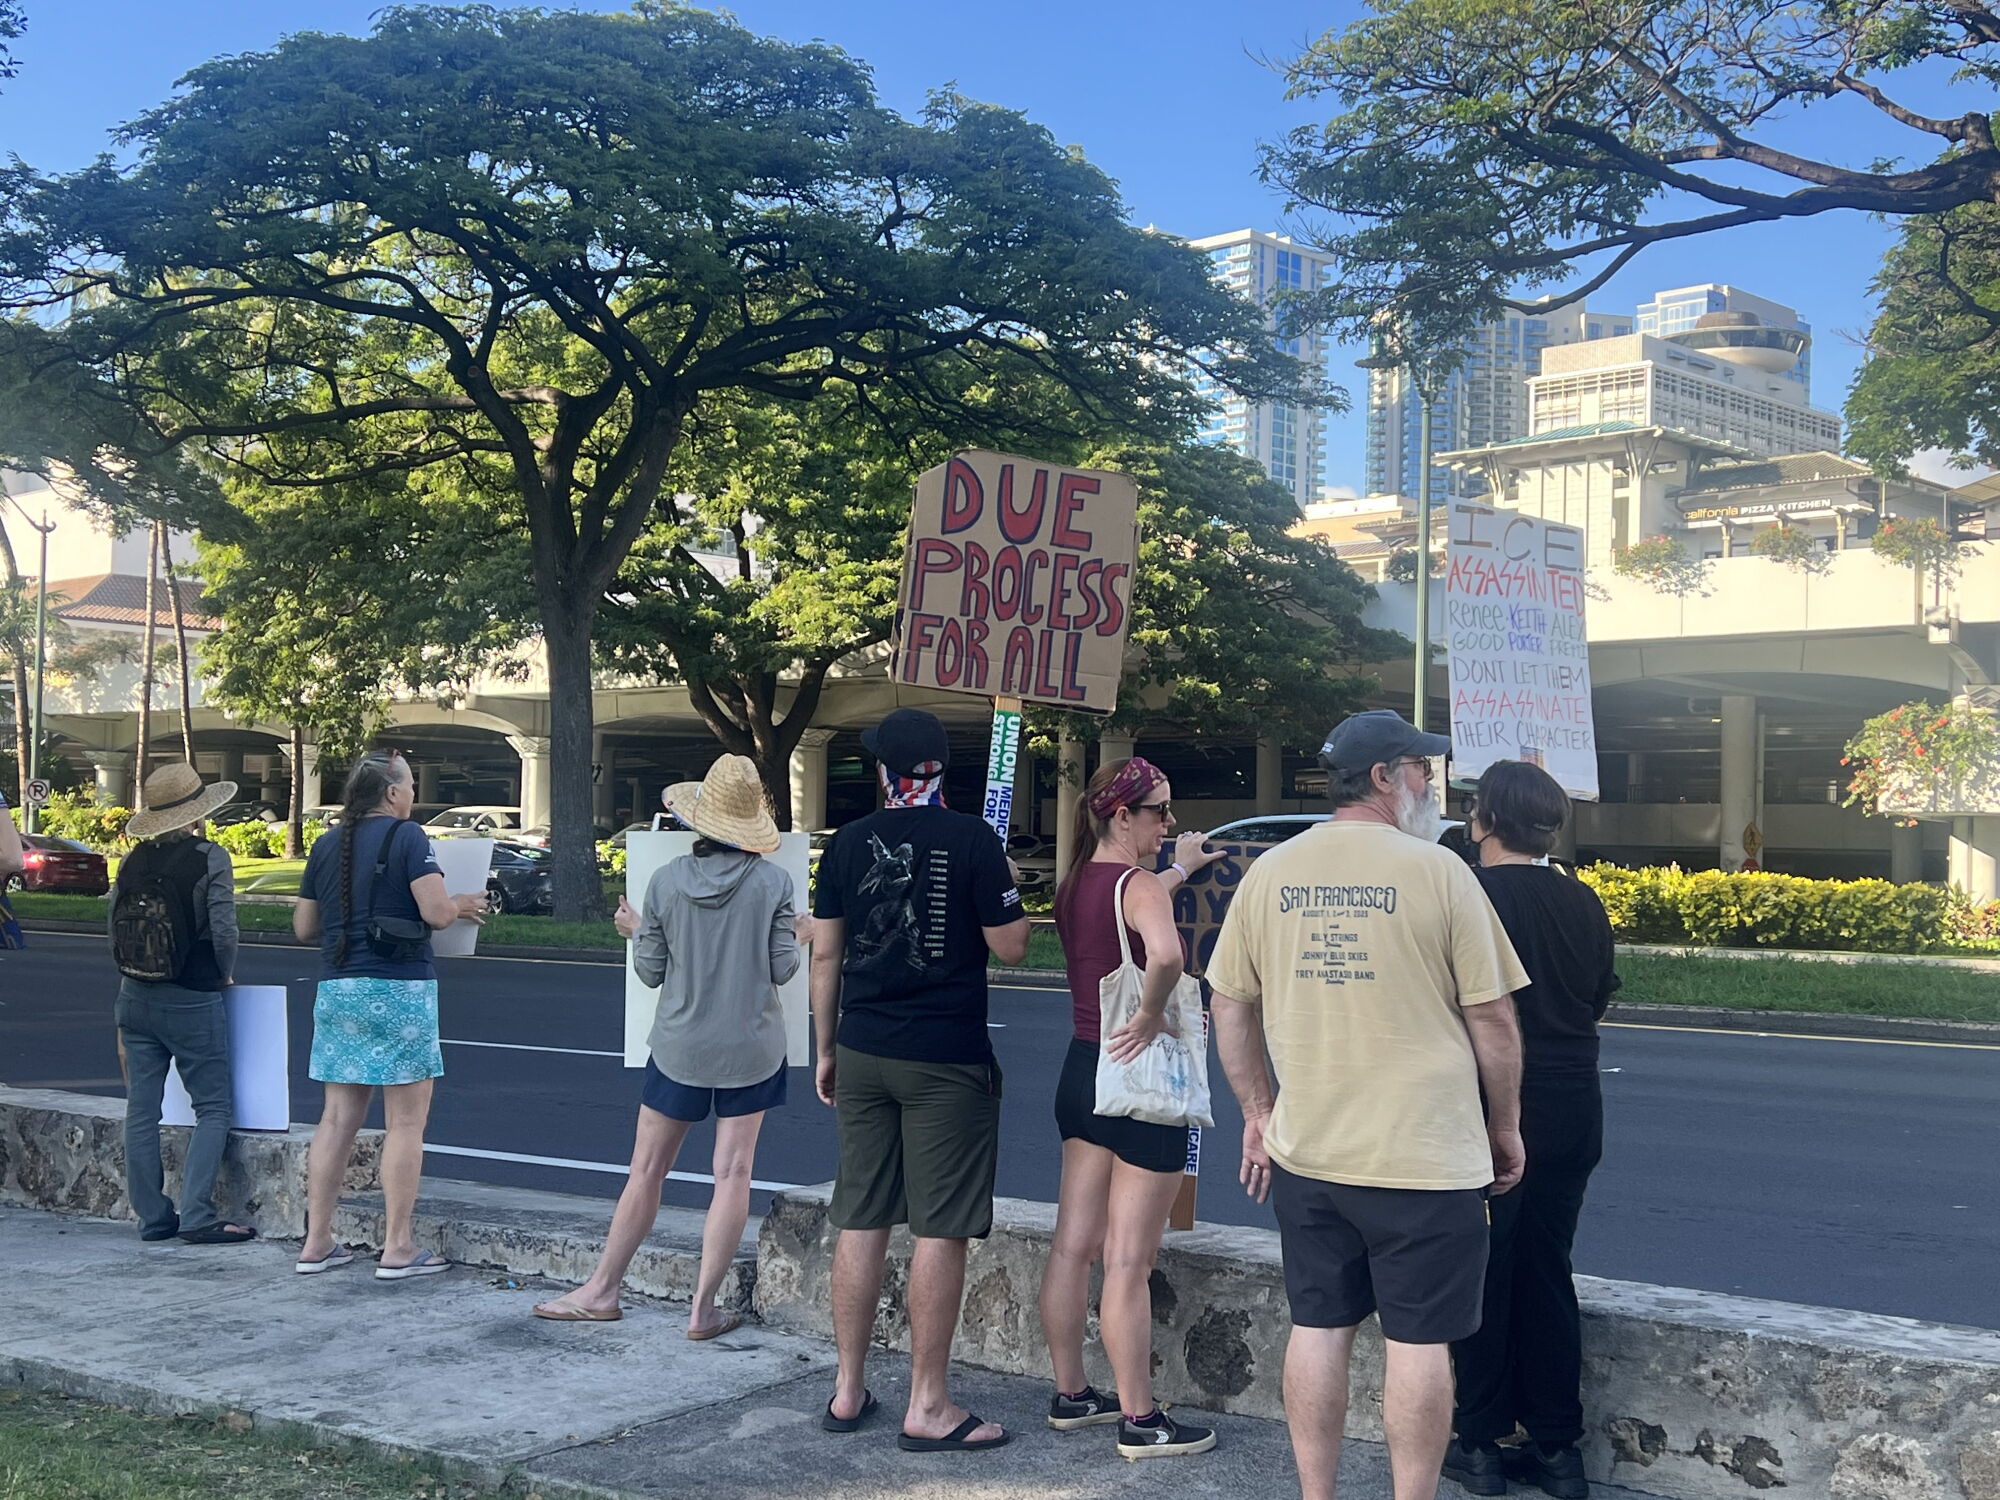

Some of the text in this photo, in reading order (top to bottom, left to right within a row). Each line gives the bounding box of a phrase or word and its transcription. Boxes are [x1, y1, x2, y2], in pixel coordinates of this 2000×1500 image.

[941, 458, 1101, 552] DUE
[1684, 499, 1831, 519] california PIZZA KITCHEN
[909, 538, 1129, 637] PROCESS
[1508, 602, 1547, 635] KEITH
[903, 613, 1087, 701] FOR ALL
[1453, 631, 1504, 652] GOOD
[1453, 655, 1587, 694] DONT LET THEM
[1454, 688, 1588, 724] ASSASSINATE
[987, 714, 1005, 779] STRONG
[1001, 716, 1021, 782] UNION
[1453, 720, 1593, 751] THEIR CHARACTER
[984, 788, 999, 819] FOR
[1280, 886, 1397, 914] SAN FRANCISCO
[1331, 933, 1358, 942] STRINGS
[1348, 952, 1368, 961] SKIES
[1296, 970, 1314, 978] TREY
[1354, 971, 1375, 980] BAND
[1186, 1127, 1200, 1173] ICARE
